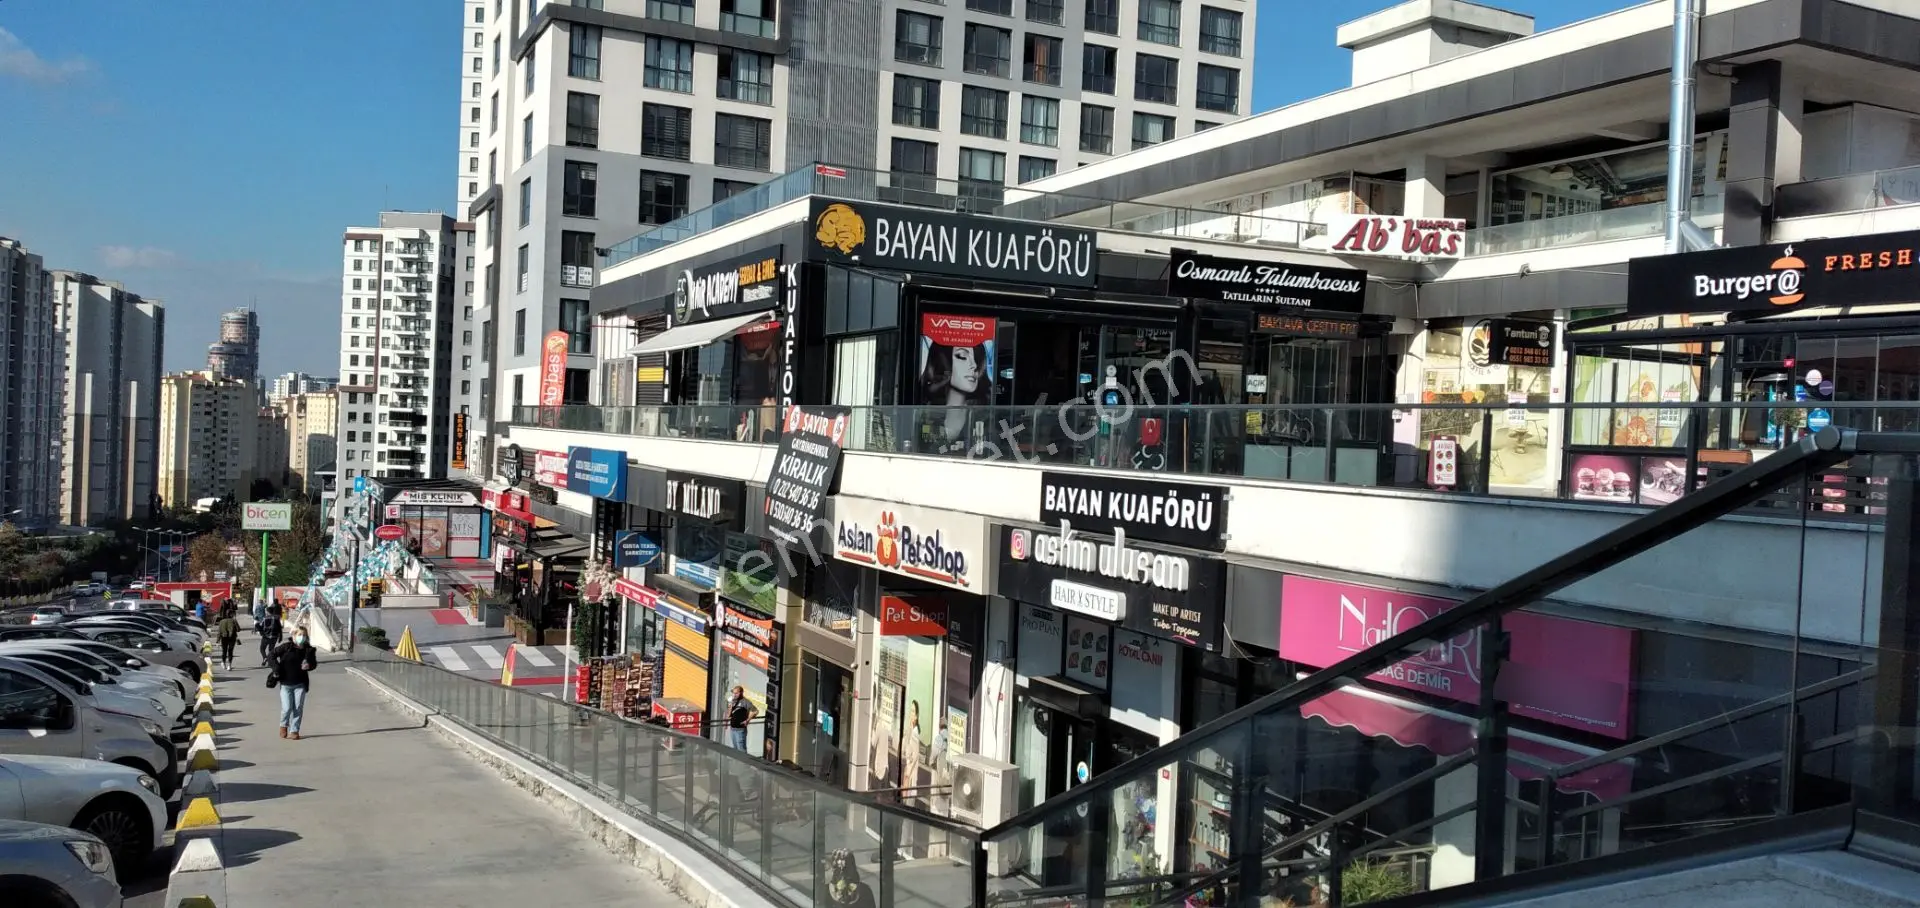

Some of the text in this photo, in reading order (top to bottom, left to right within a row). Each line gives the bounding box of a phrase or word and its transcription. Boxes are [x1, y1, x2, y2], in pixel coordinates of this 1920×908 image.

[875, 218, 1091, 278] BAYAN KUAFÖRÜ
[1825, 249, 1912, 272] FRESH
[1177, 260, 1252, 284] Osmanlı
[1222, 290, 1311, 307] TATLILARIN SULTANI
[931, 319, 985, 331] VASSO
[778, 451, 828, 487] KİRALIK
[666, 478, 720, 519] BY MİLANO
[773, 478, 820, 510] 0 212 540 36 36
[1045, 485, 1213, 531] BAYAN KUAFÖRÜ
[790, 510, 801, 529] 36
[801, 514, 813, 533] 36
[838, 520, 874, 554] Aslan
[1054, 584, 1116, 615] HAIR STYLE
[886, 606, 945, 623] Pet Shop
[1153, 602, 1201, 623] MAKE UP ARTIST
[1408, 667, 1452, 692] DEMİR
